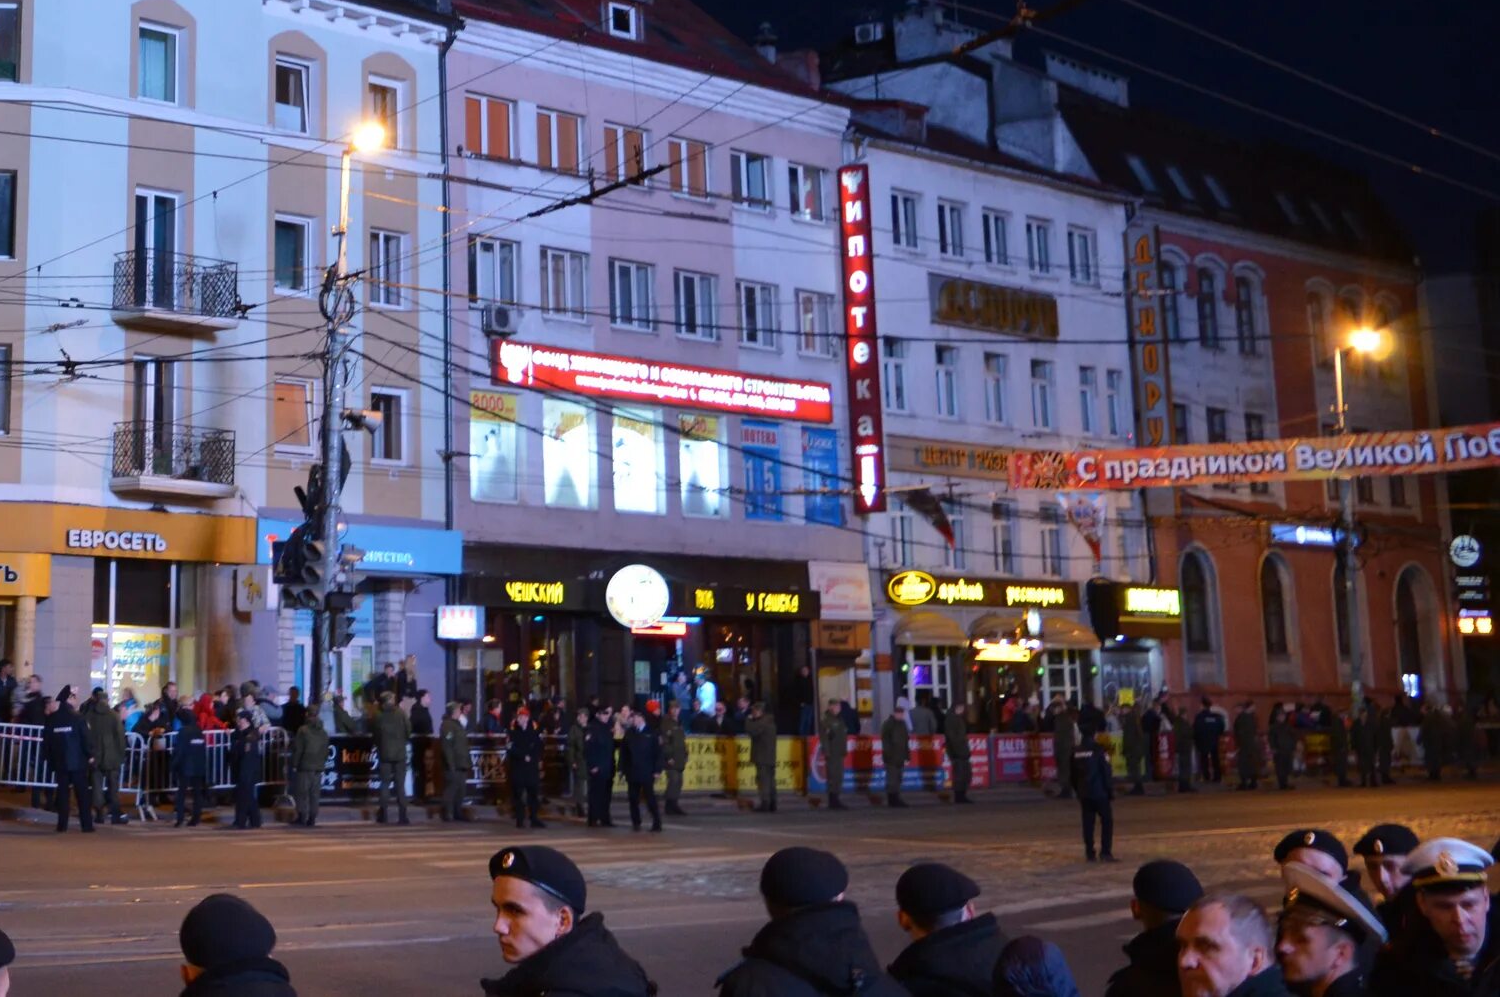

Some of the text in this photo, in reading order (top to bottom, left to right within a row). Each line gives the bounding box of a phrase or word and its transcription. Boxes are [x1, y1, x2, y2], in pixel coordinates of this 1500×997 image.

[1130, 235, 1163, 445] ДЕКОРУ
[1077, 456, 1097, 480] С
[1104, 451, 1287, 484] праздником
[1295, 432, 1435, 470] Великой
[66, 529, 168, 553] ЕВРОСЕТЬ
[505, 581, 564, 605] ЧЕШСКИЙ
